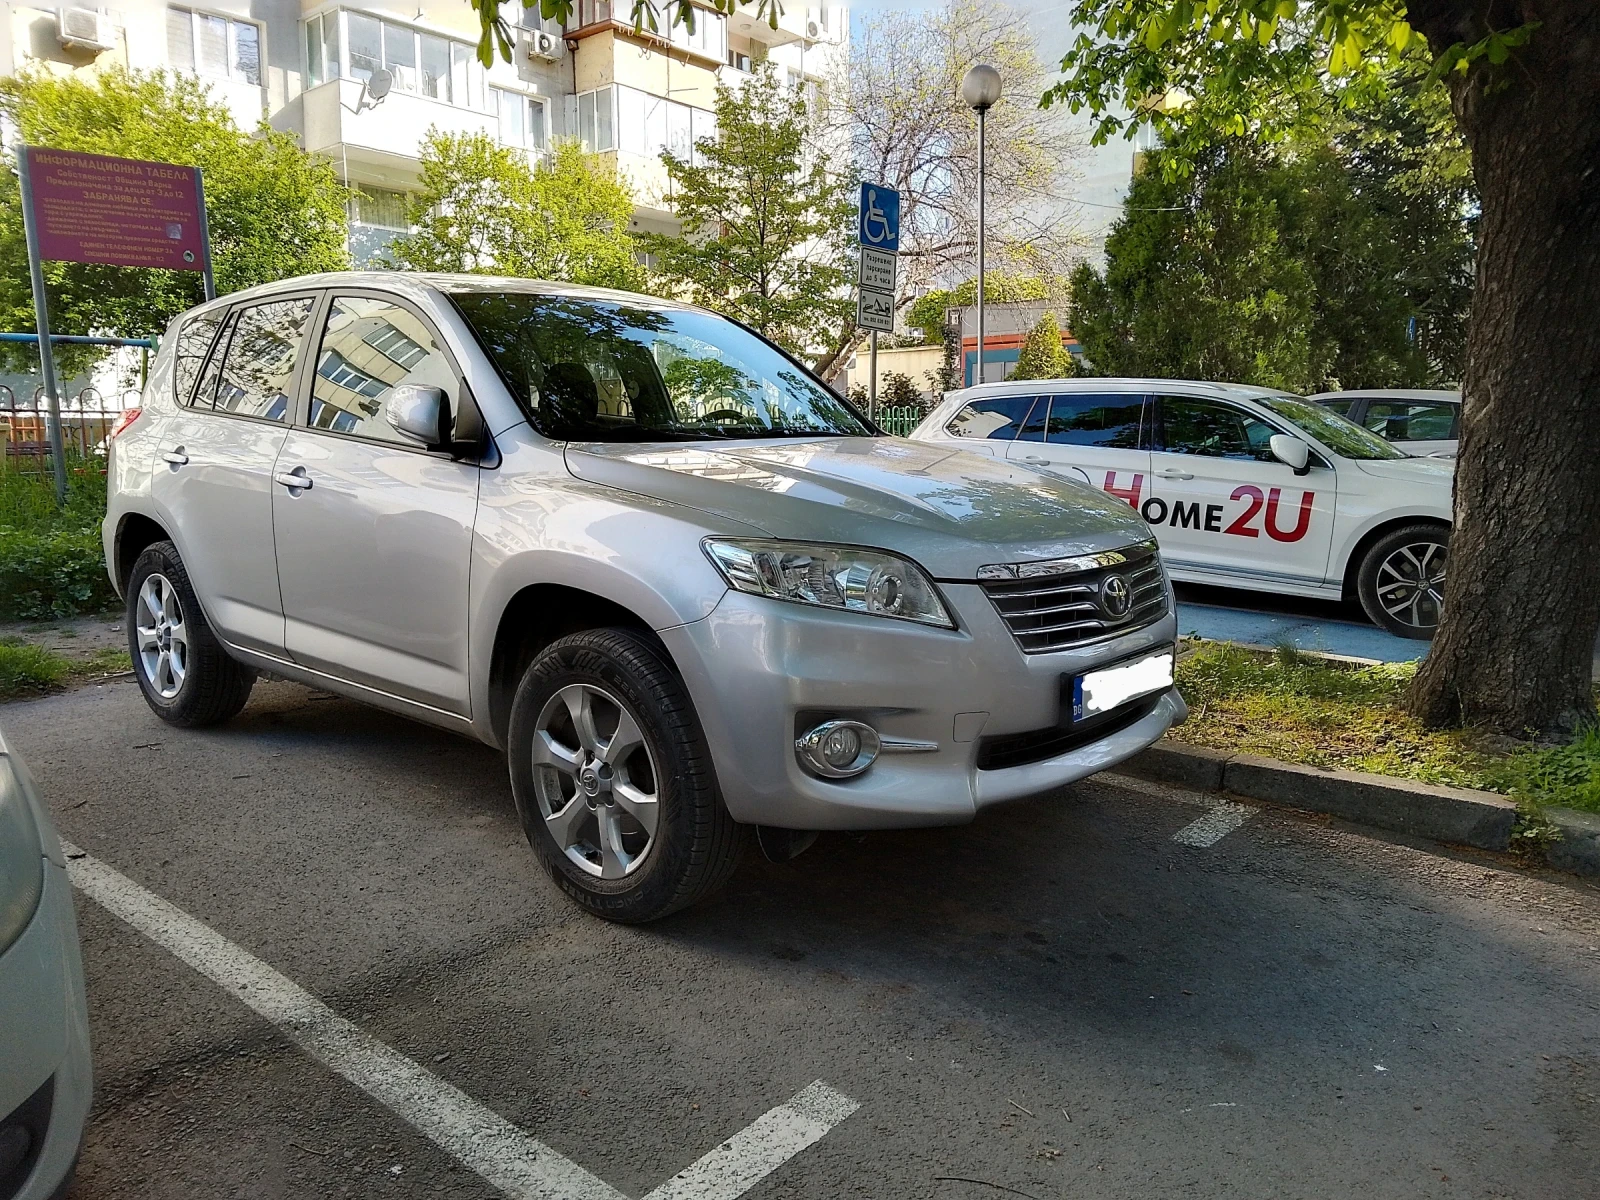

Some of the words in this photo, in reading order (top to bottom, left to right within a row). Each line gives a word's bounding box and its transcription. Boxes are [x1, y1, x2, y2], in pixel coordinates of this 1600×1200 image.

[35, 153, 143, 176] ИНФОРМАЦИОННА
[146, 167, 189, 181] ТАБЕЛА
[46, 176, 112, 191] Предназначена
[124, 186, 144, 194] деца
[115, 176, 146, 186] Община
[148, 180, 172, 190] Варна
[83, 191, 138, 204] ЗАБРАНЯВА
[866, 253, 892, 266] Разрешено
[866, 264, 890, 275] паркиране
[1073, 704, 1082, 716] BG
